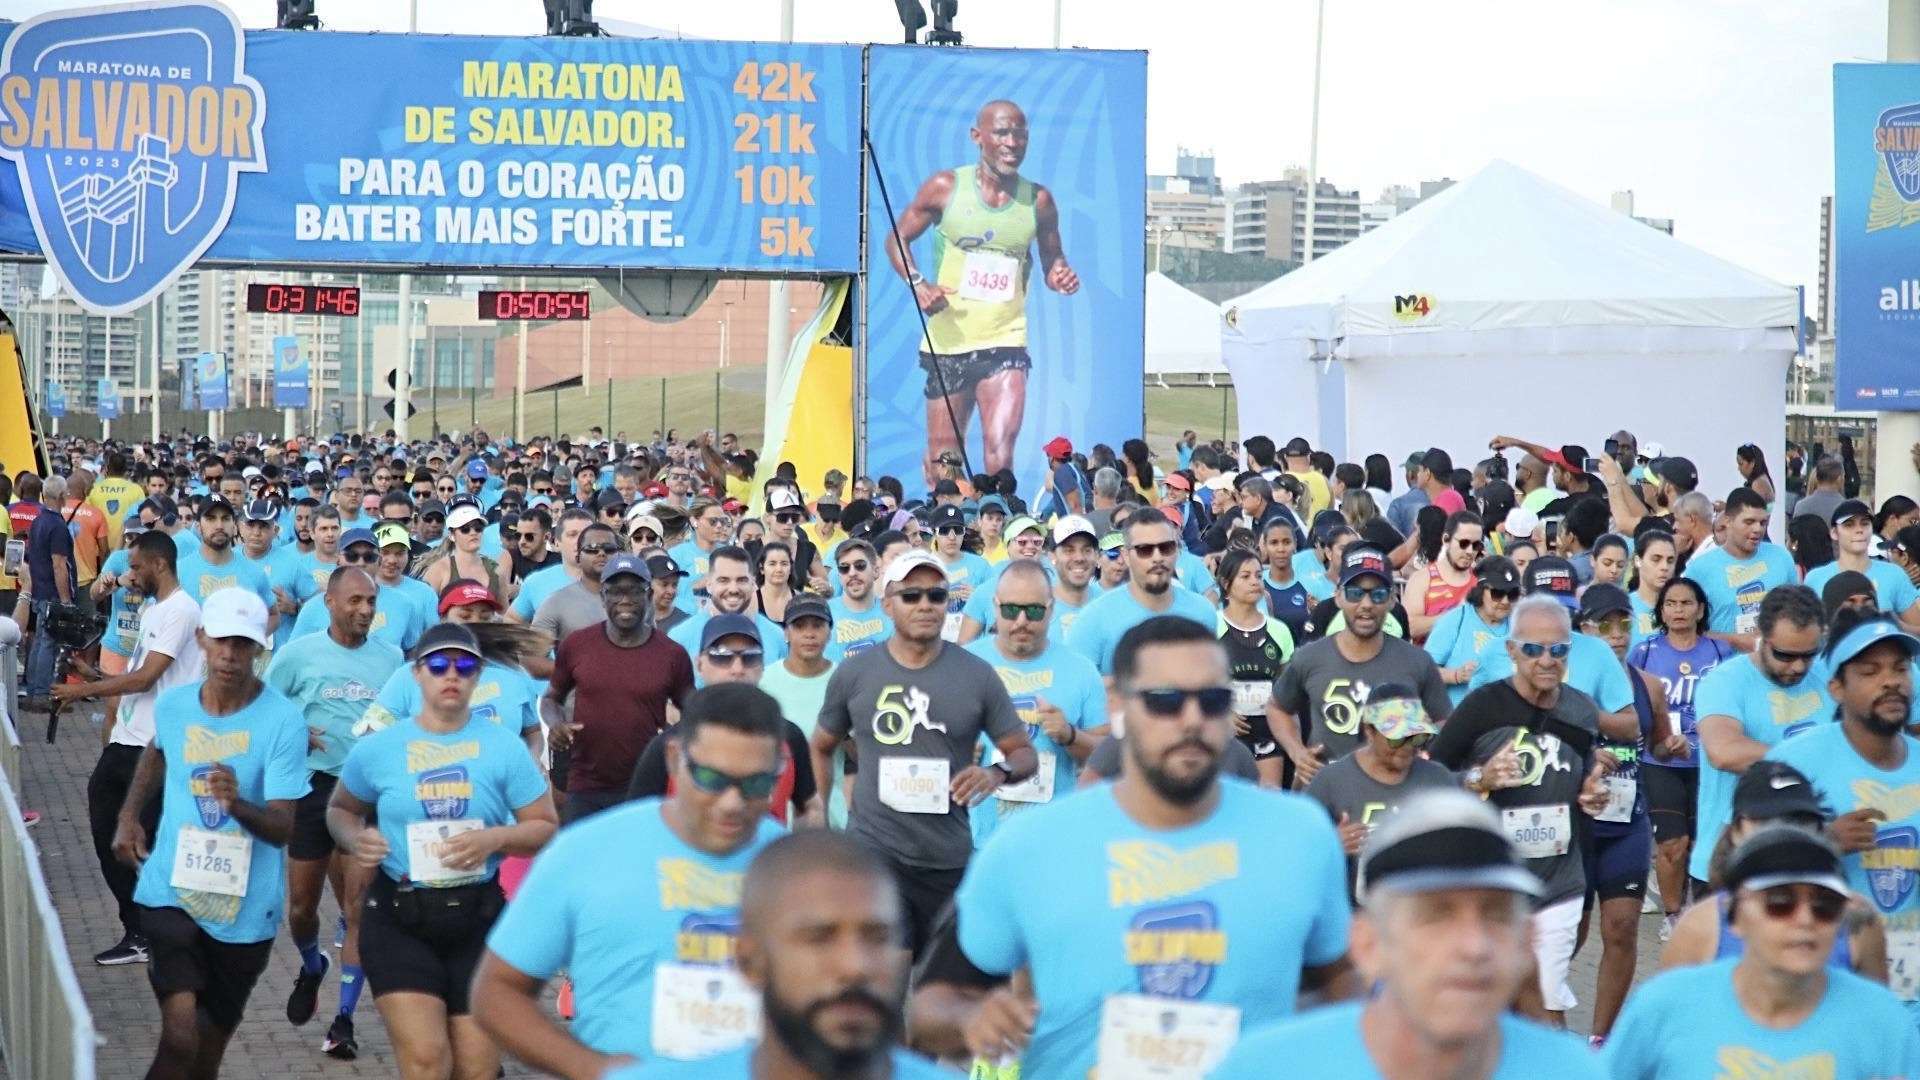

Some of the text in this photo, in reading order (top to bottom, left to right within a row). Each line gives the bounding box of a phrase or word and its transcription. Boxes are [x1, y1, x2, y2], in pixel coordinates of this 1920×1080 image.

[58, 60, 192, 80] MARATONA DE
[463, 60, 685, 102] MARATONA
[733, 61, 817, 103] 42k
[1, 75, 252, 159] SALVADOR
[405, 106, 686, 149] DE SALVADOR.
[733, 113, 816, 154] 21k
[64, 156, 120, 169] 2023
[339, 155, 685, 211] PARA O CORAÇÃO
[735, 165, 816, 206] 10k
[295, 204, 686, 248] BATER MAIS FORTE.
[760, 217, 815, 258] 5k
[265, 285, 359, 316] 0:31:46
[967, 269, 1009, 291] 3439
[495, 292, 589, 320] 0:50:54
[99, 486, 127, 494] STAFF
[1515, 826, 1557, 843] 50050
[185, 853, 232, 874] 51285
